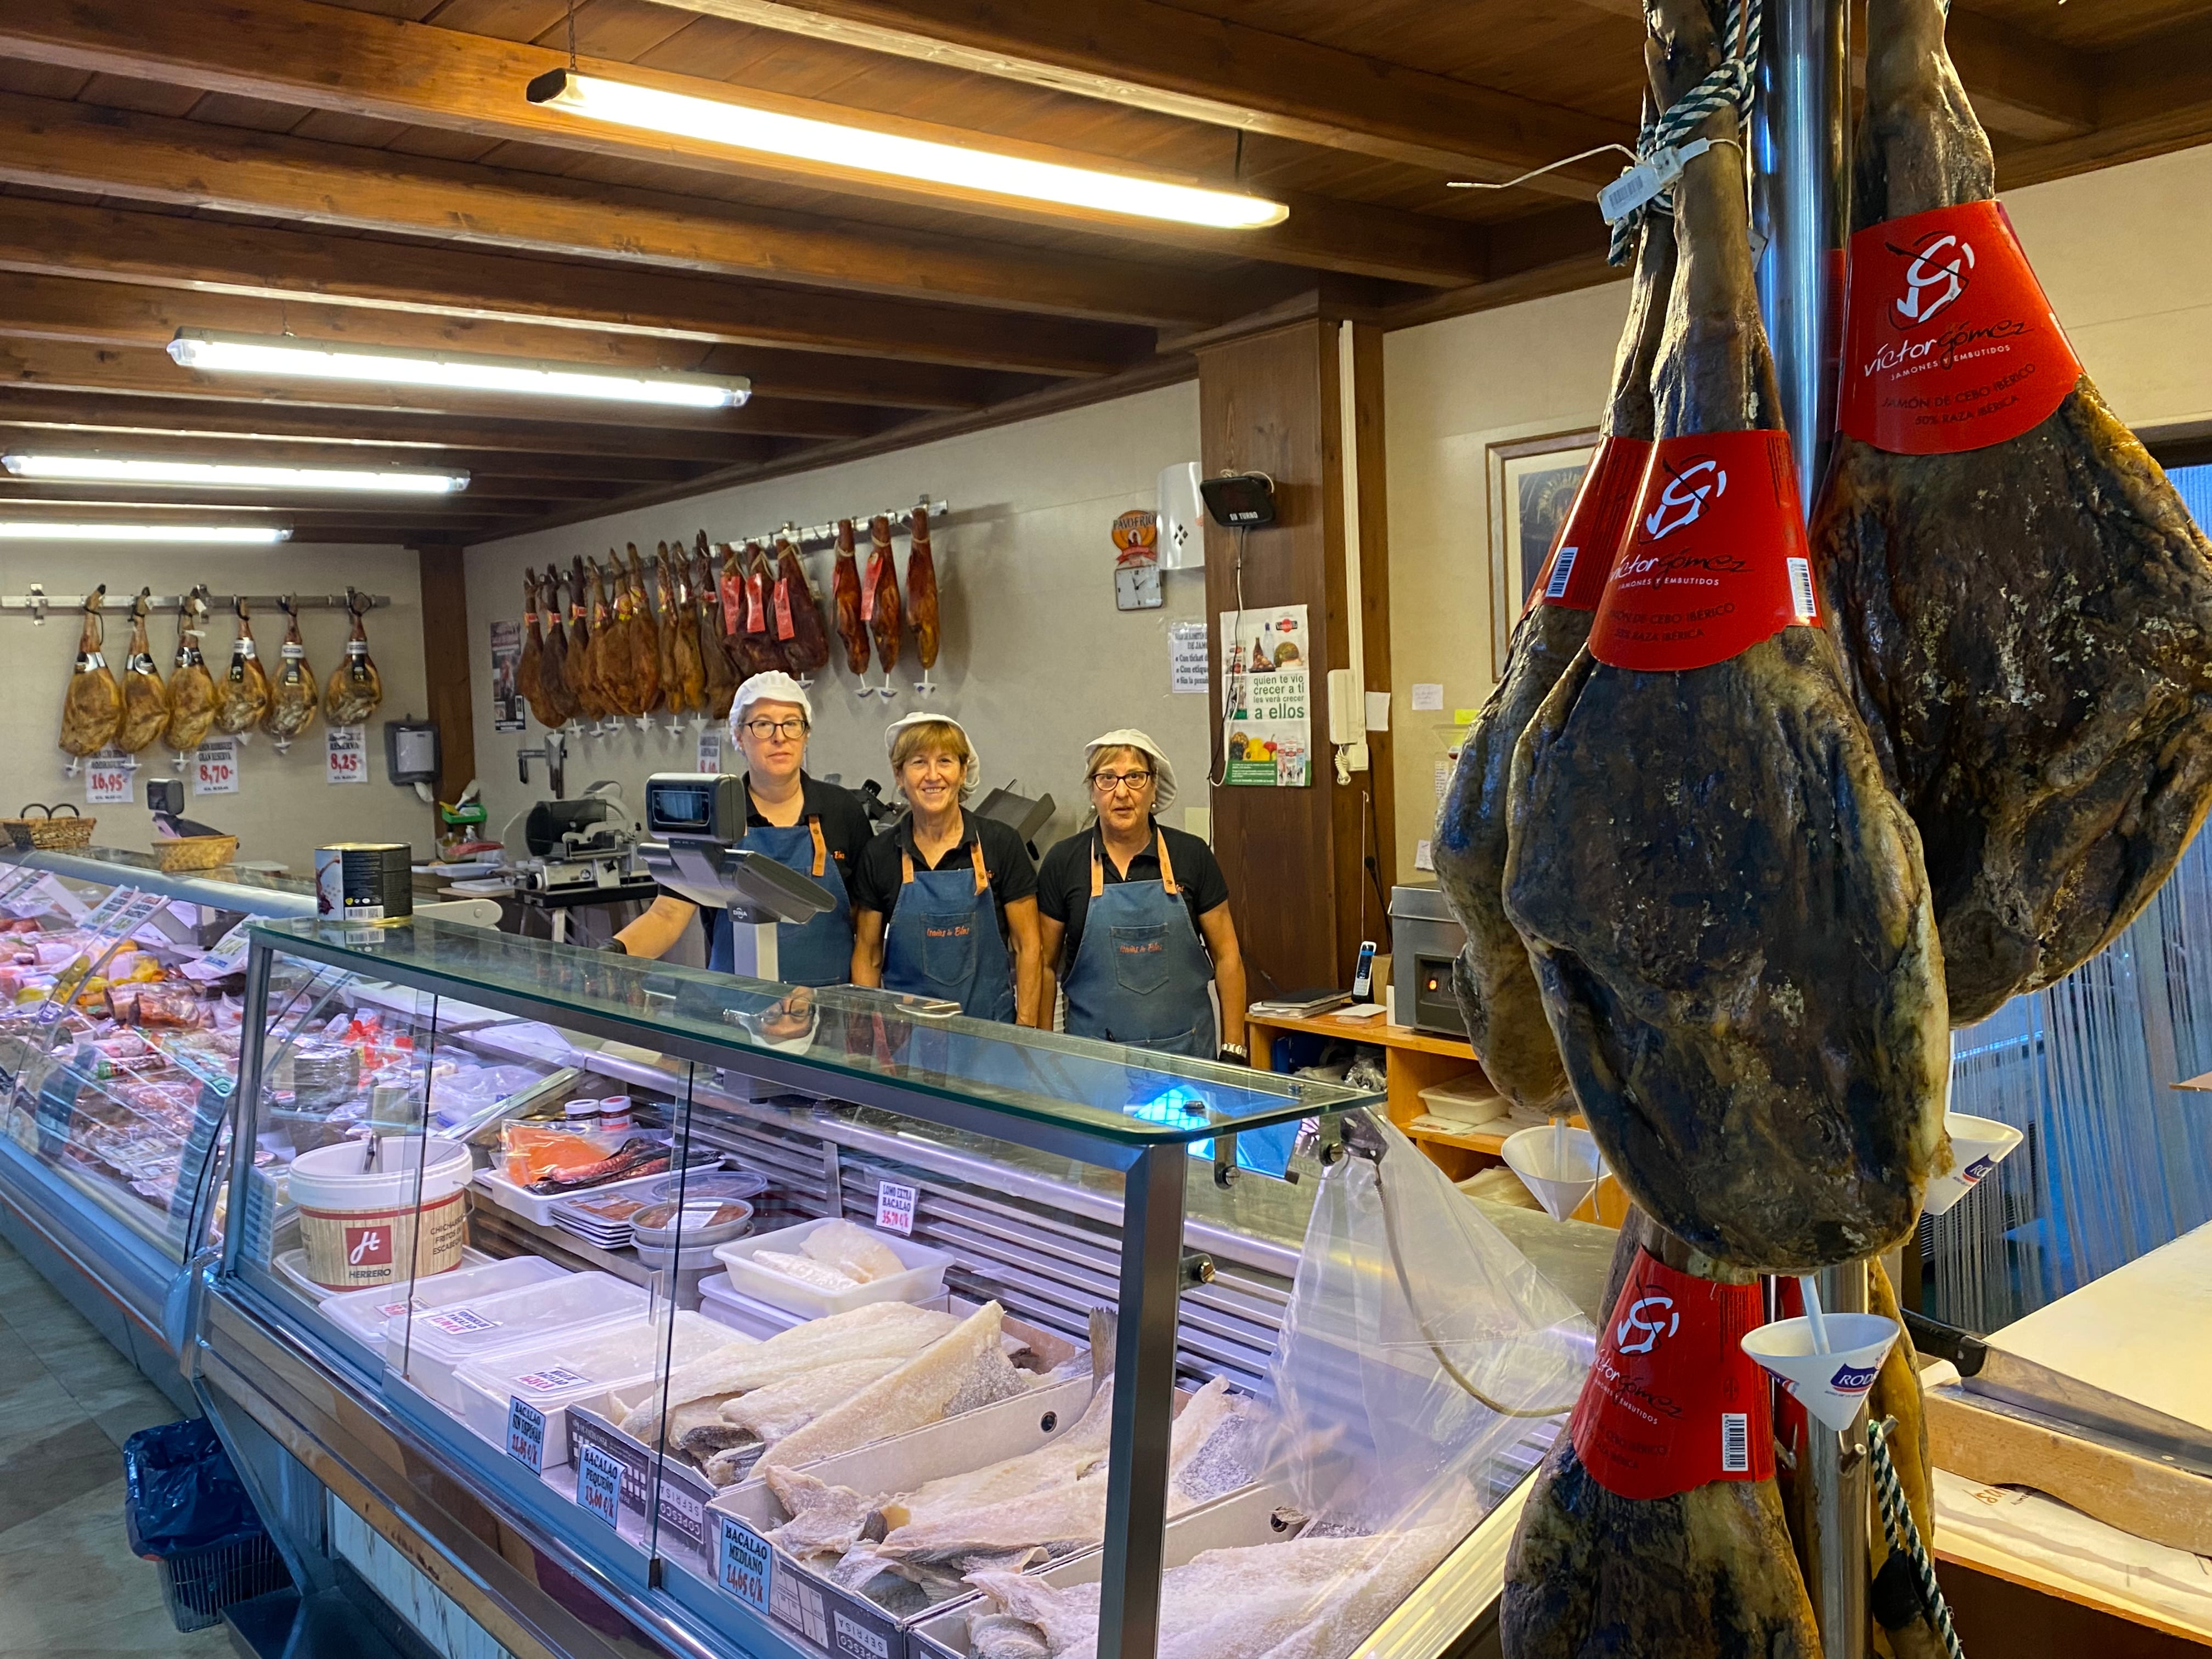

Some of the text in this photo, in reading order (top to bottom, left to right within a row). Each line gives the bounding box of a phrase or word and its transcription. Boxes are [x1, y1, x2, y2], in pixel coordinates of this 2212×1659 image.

[1891, 360, 1938, 381] JAMONES
[1954, 345, 2011, 362] EMBUTIDOS
[1882, 395, 1929, 410] JAMÓN
[1934, 396, 1951, 407] DE
[1955, 386, 1991, 403] CEBO
[1942, 412, 1974, 423] RAZA
[1239, 511, 1258, 520] TURNO
[1664, 577, 1719, 586] EMBUTIDOS
[1649, 613, 1683, 624] CEBO
[1187, 641, 1207, 650] DE JAM
[1189, 653, 1204, 662] ticket
[1180, 664, 1207, 675] Con etiqu
[1254, 674, 1304, 686] quien te vio
[1254, 686, 1284, 695] crecer
[1265, 695, 1280, 703] verá
[1255, 703, 1305, 719] a ellos
[883, 1184, 912, 1201] LOMO EXTRA
[882, 1197, 911, 1212] BACALAO
[436, 1229, 456, 1244] FRITOS
[348, 1268, 391, 1279] HERRERO
[447, 1314, 477, 1329] BACALAO
[534, 1372, 569, 1385] BACALAO
[515, 1402, 540, 1425] BACALAO
[1619, 1397, 1658, 1425] EMBUTIDOS
[512, 1413, 521, 1430] SIN
[584, 1448, 618, 1479] BACALAO
[585, 1467, 613, 1494] PEQUEÑO
[659, 1486, 699, 1516] SEFRISA
[660, 1503, 701, 1535] COPESCO
[725, 1525, 767, 1560] BACALAO
[729, 1543, 763, 1576] MEDIANO
[838, 1617, 883, 1652] SEFRISA
